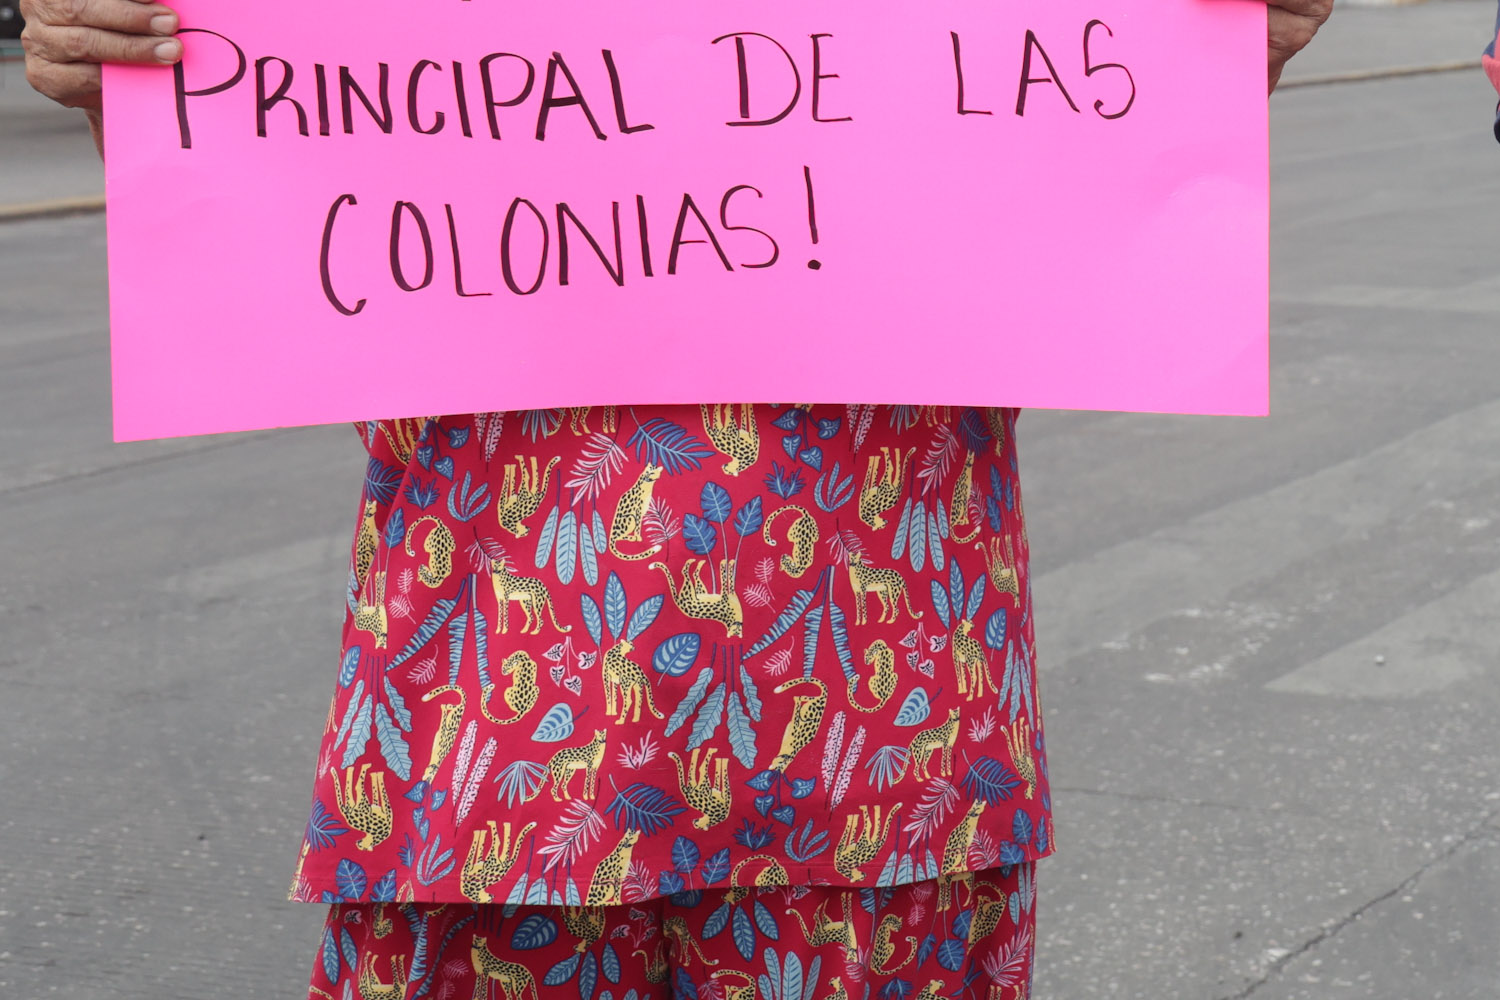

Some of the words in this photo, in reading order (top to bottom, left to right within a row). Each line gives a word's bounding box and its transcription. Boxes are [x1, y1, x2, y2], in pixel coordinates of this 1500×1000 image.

[175, 27, 655, 150] PRINCIPAL
[711, 31, 854, 127] DE
[950, 19, 1137, 120] LAS
[319, 165, 824, 316] COLONIAS!
